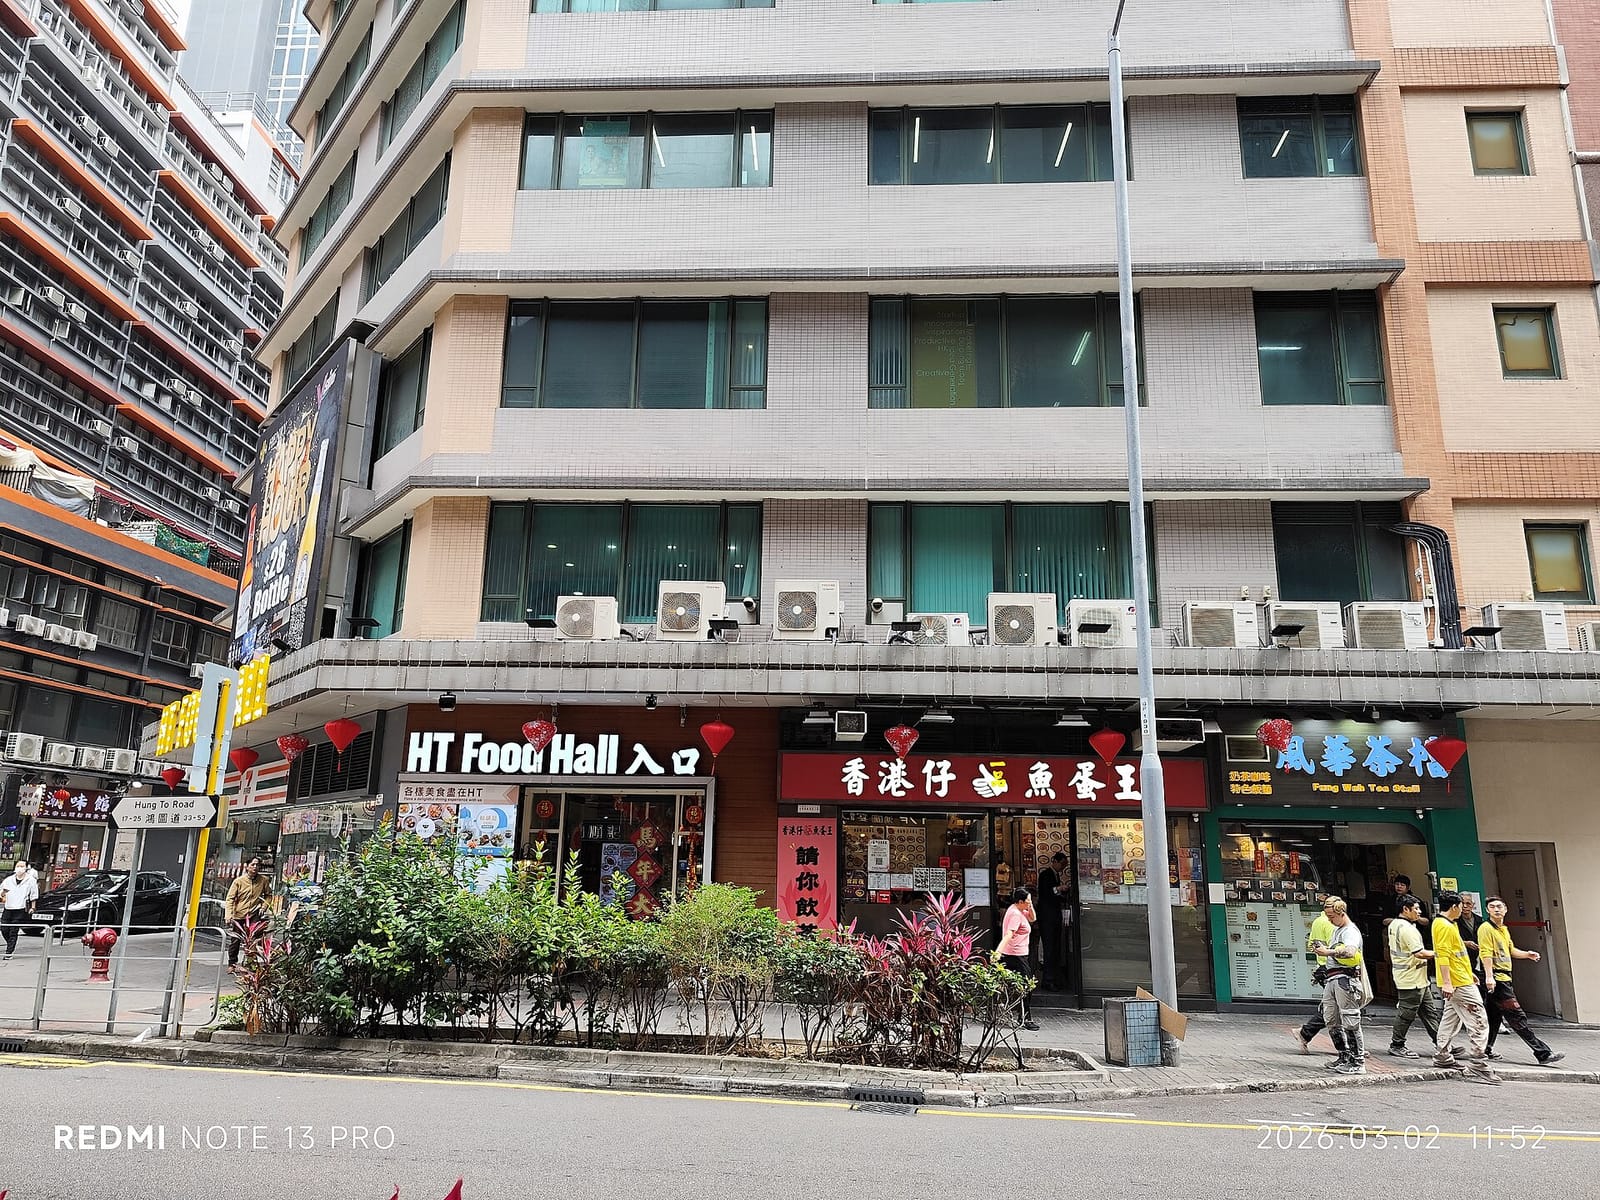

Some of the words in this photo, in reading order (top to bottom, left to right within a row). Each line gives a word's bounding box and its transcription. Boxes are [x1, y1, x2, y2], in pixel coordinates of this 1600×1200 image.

[257, 459, 312, 555] HOUR
[263, 539, 287, 584] $28
[252, 574, 290, 620] Bottle
[407, 732, 455, 773] HT
[549, 733, 620, 775] Hall
[624, 742, 700, 775] 入口
[134, 800, 157, 810] Hung
[160, 800, 170, 809] To
[172, 800, 195, 808] Road
[1312, 782, 1340, 794] Fung
[1368, 783, 1390, 793] Tea
[1393, 783, 1421, 793] Stall
